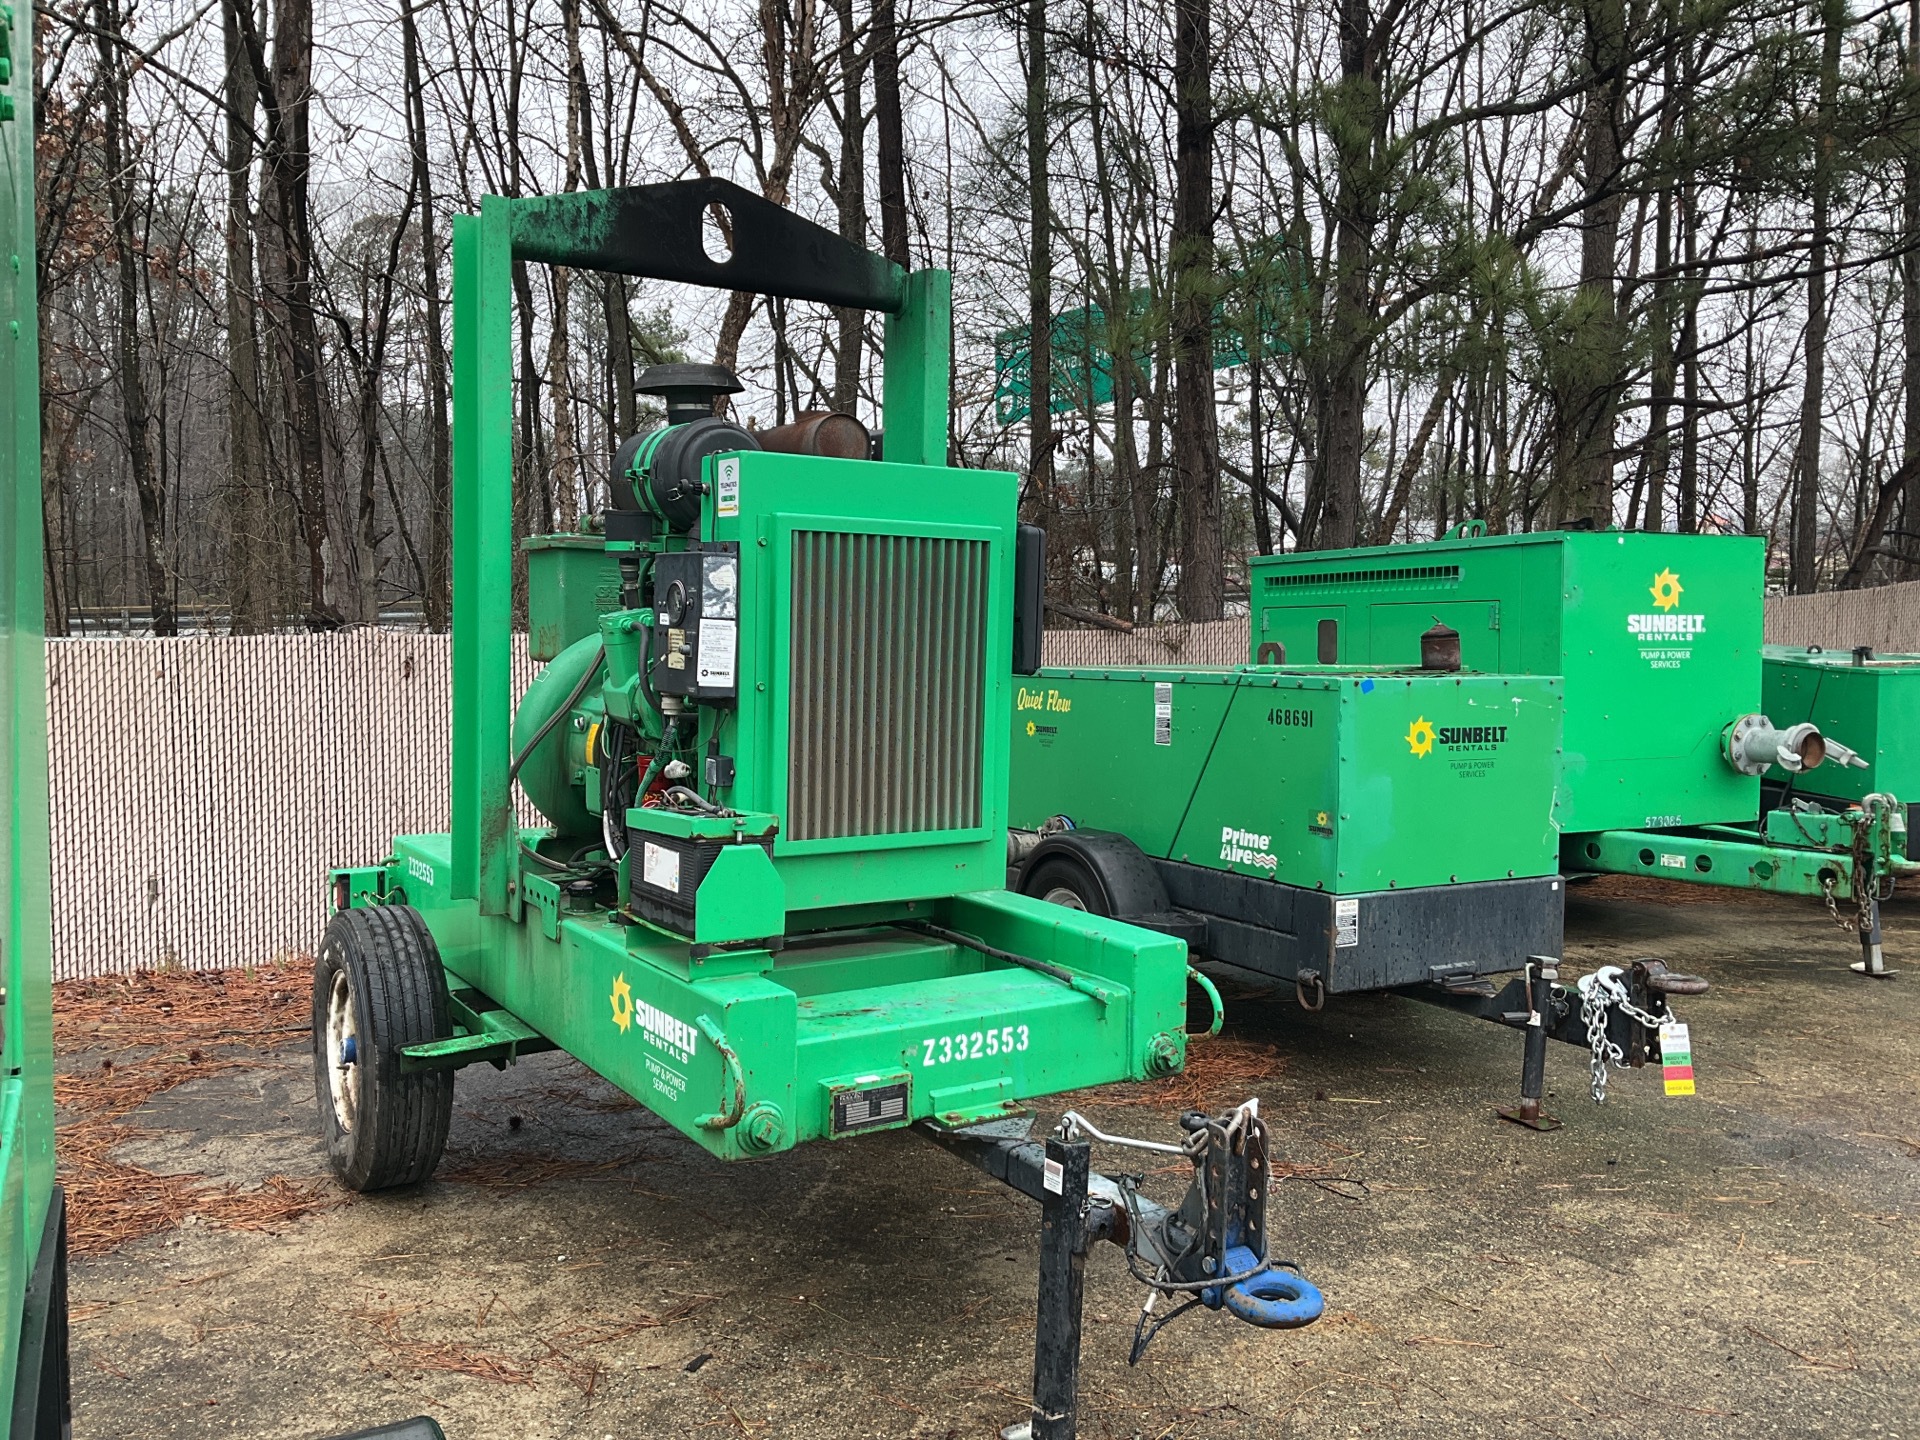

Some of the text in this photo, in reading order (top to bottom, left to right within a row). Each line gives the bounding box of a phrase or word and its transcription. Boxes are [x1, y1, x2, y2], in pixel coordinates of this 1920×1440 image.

[1627, 614, 1705, 633] SUNBELT
[1637, 633, 1693, 641] RENTALS
[1640, 650, 1691, 660] PUMP & POWER
[1650, 660, 1681, 669] SERVICES
[1017, 687, 1071, 712] Quiet Flow
[1267, 708, 1313, 728] 468691
[1035, 725, 1057, 734] SUNBELT
[1439, 726, 1507, 744] SUNBELT
[1448, 744, 1497, 752] RENTALS
[1450, 762, 1468, 770] PUMP
[1474, 761, 1495, 769] POWER
[1459, 770, 1486, 778] SERVICES
[1645, 814, 1682, 828] 573085
[1221, 826, 1270, 850] Prime
[1219, 844, 1253, 865] Aire
[408, 856, 434, 886] Z332553
[635, 998, 698, 1056] SUNBELT
[643, 1029, 688, 1065] RENTALS
[922, 1024, 1029, 1067] Z332553
[645, 1058, 686, 1093] PUMP & POWER
[652, 1077, 677, 1102] SERVICES
